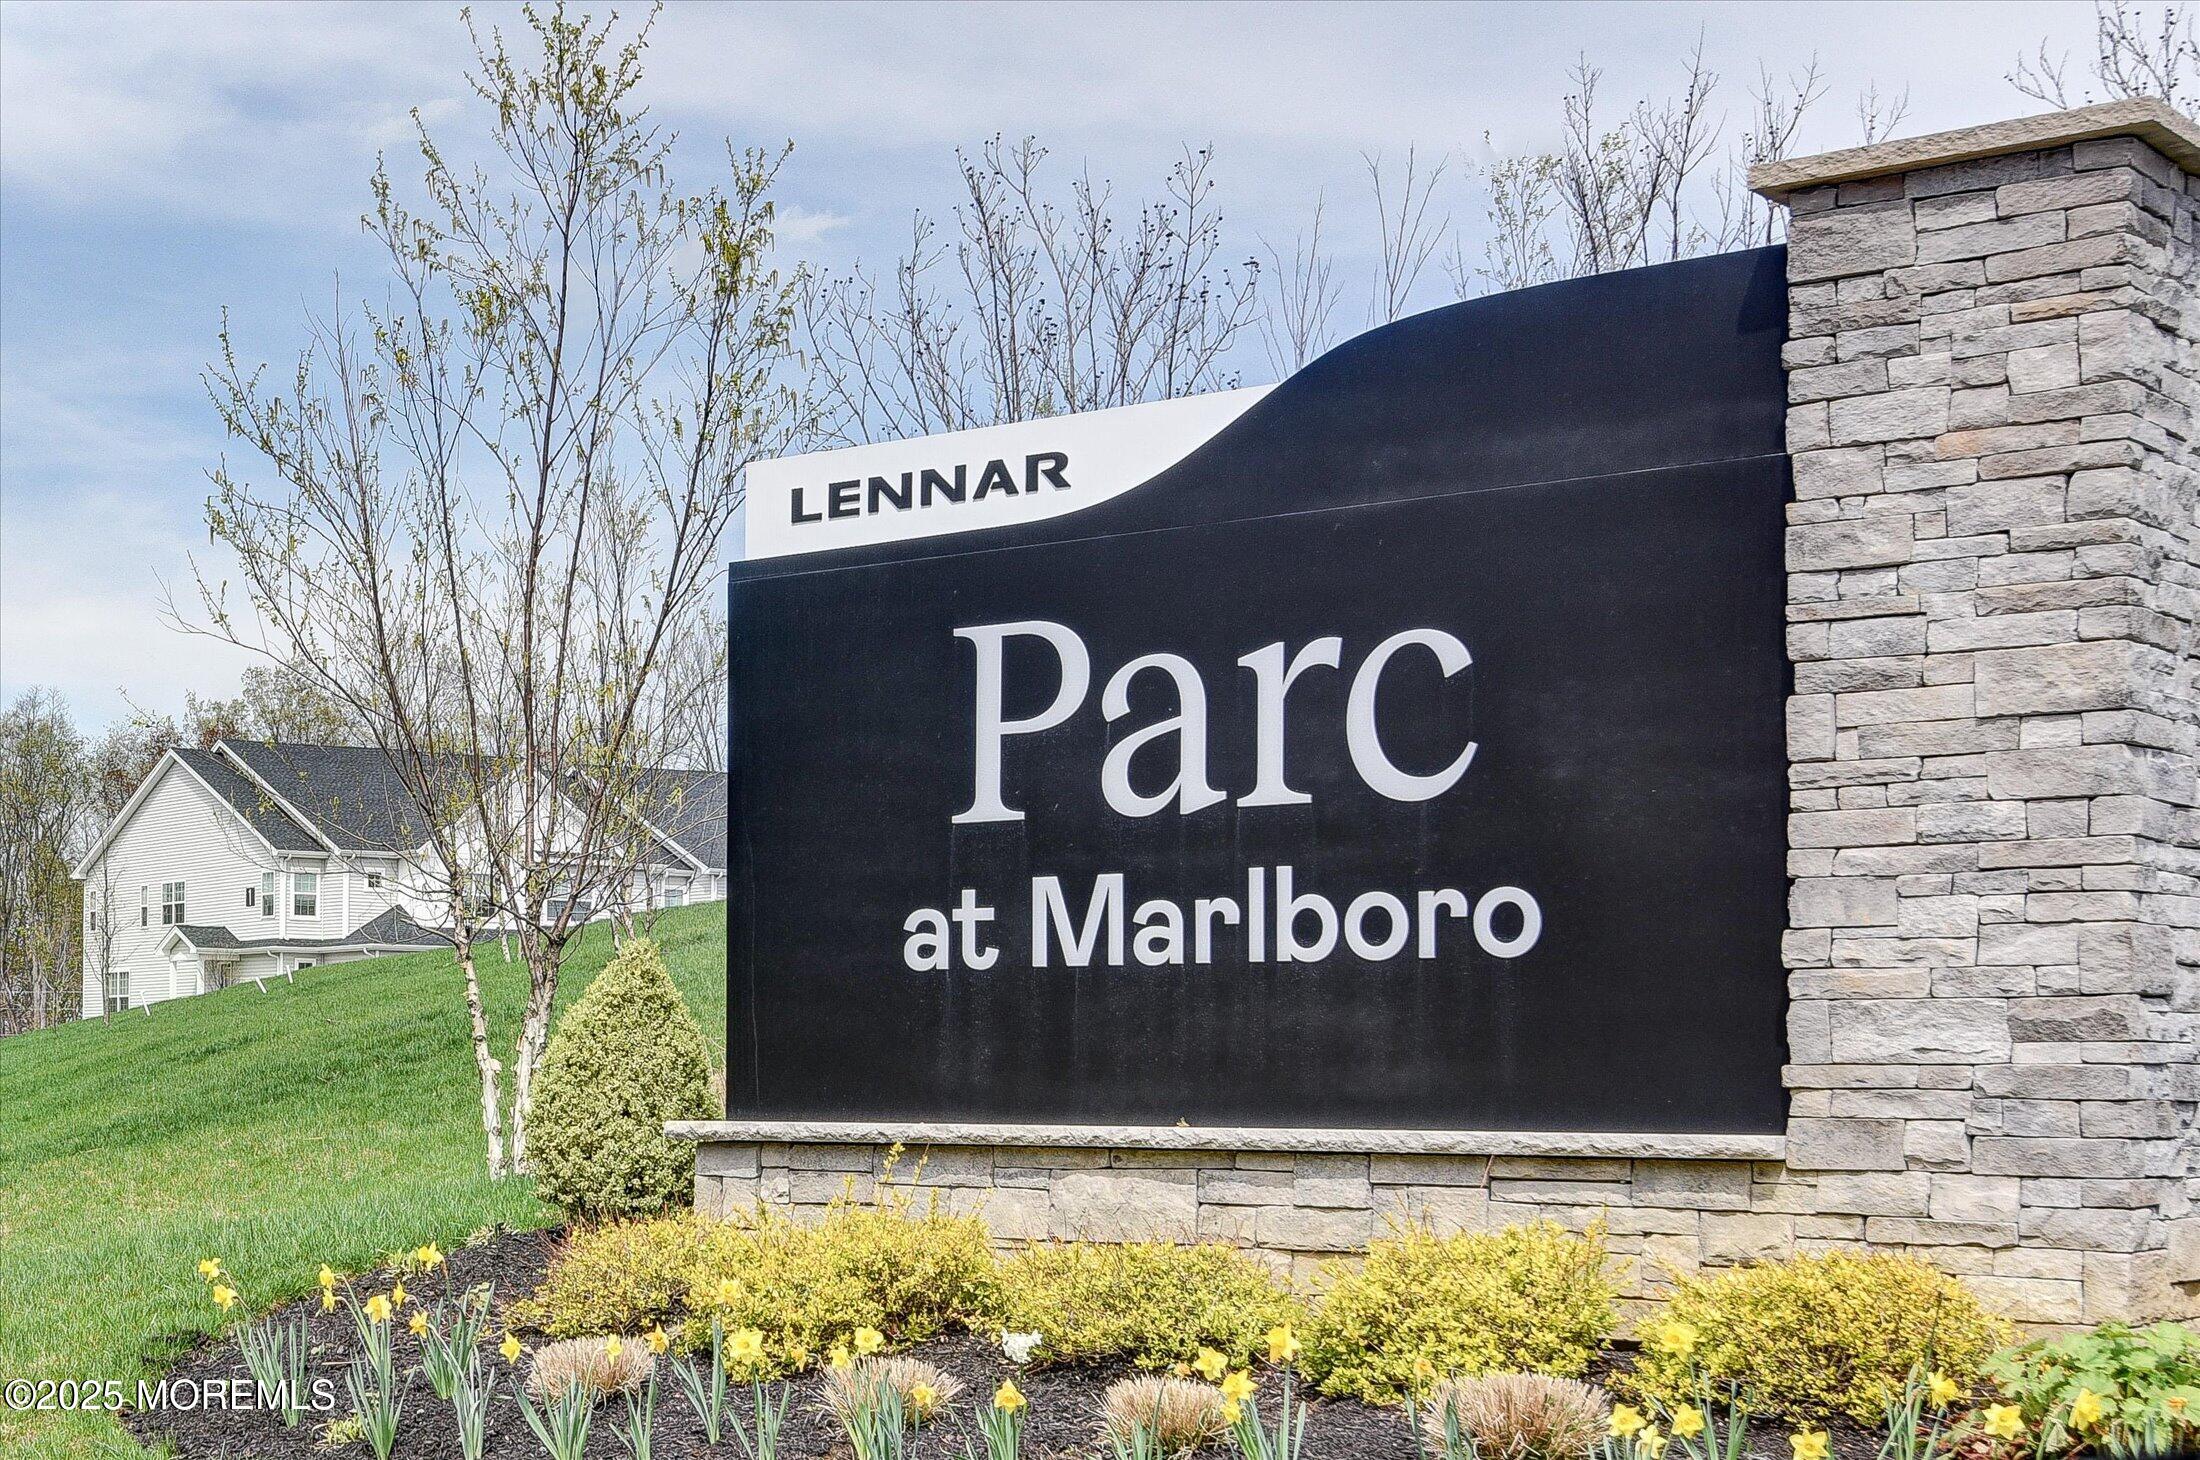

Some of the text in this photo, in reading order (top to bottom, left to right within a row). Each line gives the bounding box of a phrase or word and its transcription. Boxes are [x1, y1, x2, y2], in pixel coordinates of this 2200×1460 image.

[791, 451, 1072, 524] LENNAR
[951, 620, 1479, 824] Parc
[903, 865, 1542, 972] at Marlboro
